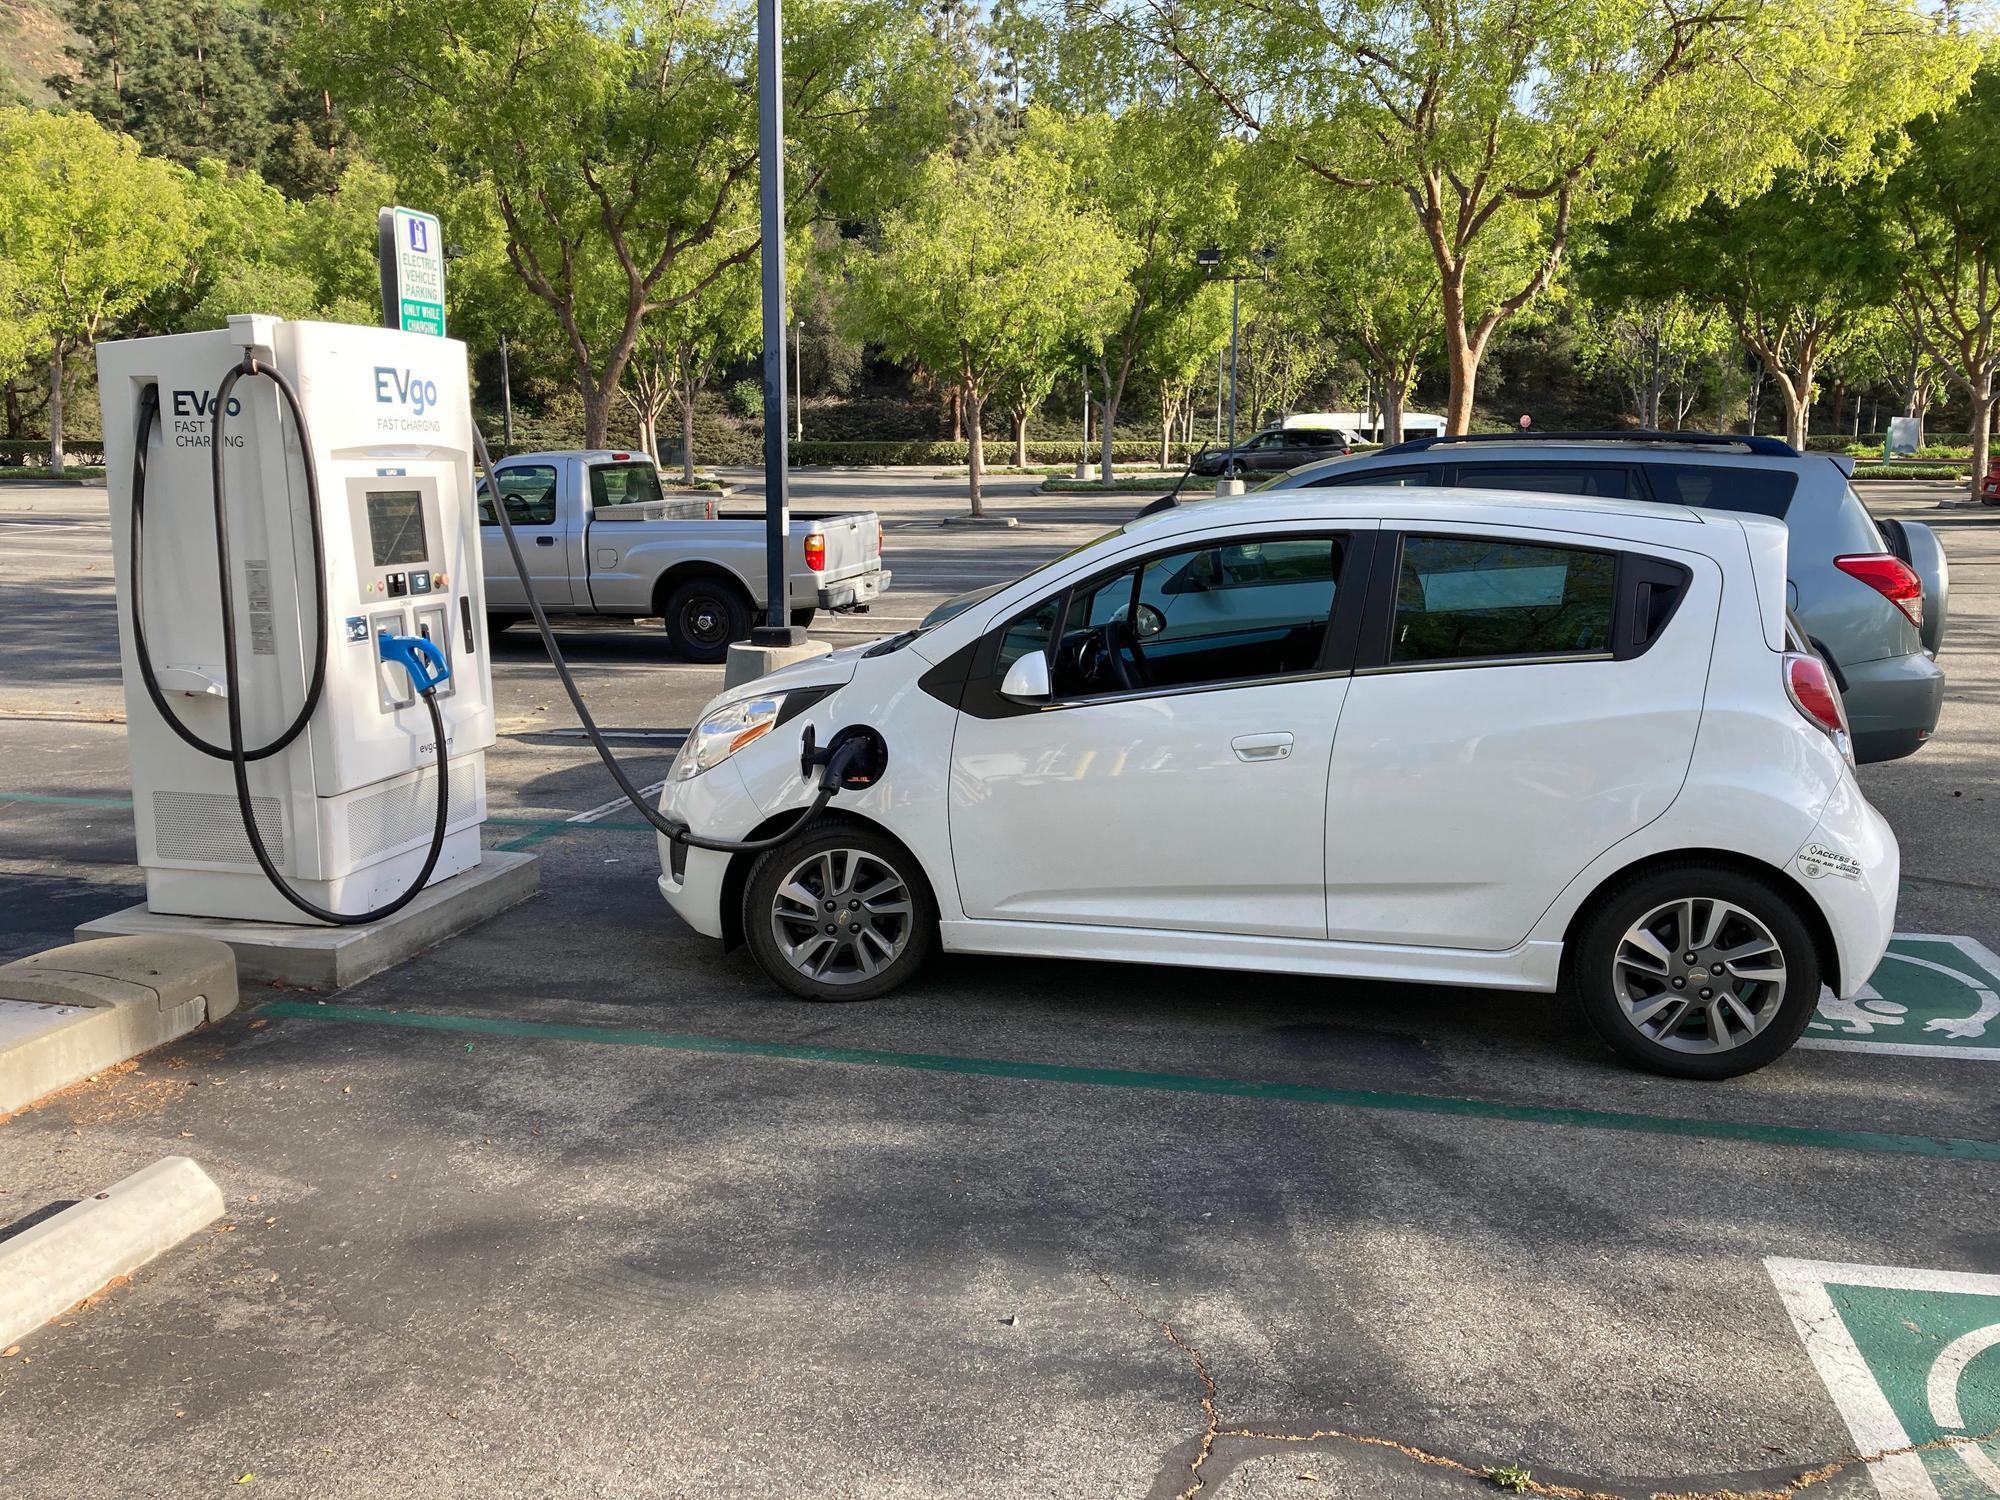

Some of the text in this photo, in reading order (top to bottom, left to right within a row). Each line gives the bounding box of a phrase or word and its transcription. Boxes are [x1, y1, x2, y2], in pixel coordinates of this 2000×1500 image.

[402, 252, 437, 271] ELECTRIC
[405, 268, 437, 286] VEHICLE
[405, 284, 438, 301] PARKING
[403, 303, 440, 320] ONLY WHILE
[407, 319, 438, 335] CHARGING
[374, 366, 437, 416] EVgo
[174, 421, 205, 433] FAST
[377, 418, 440, 432] FAST CHARGING
[176, 435, 244, 447] CHARNG
[420, 737, 454, 754] evgom
[1799, 854, 1821, 864] CLEAN
[1816, 849, 1851, 864] ACCESS
